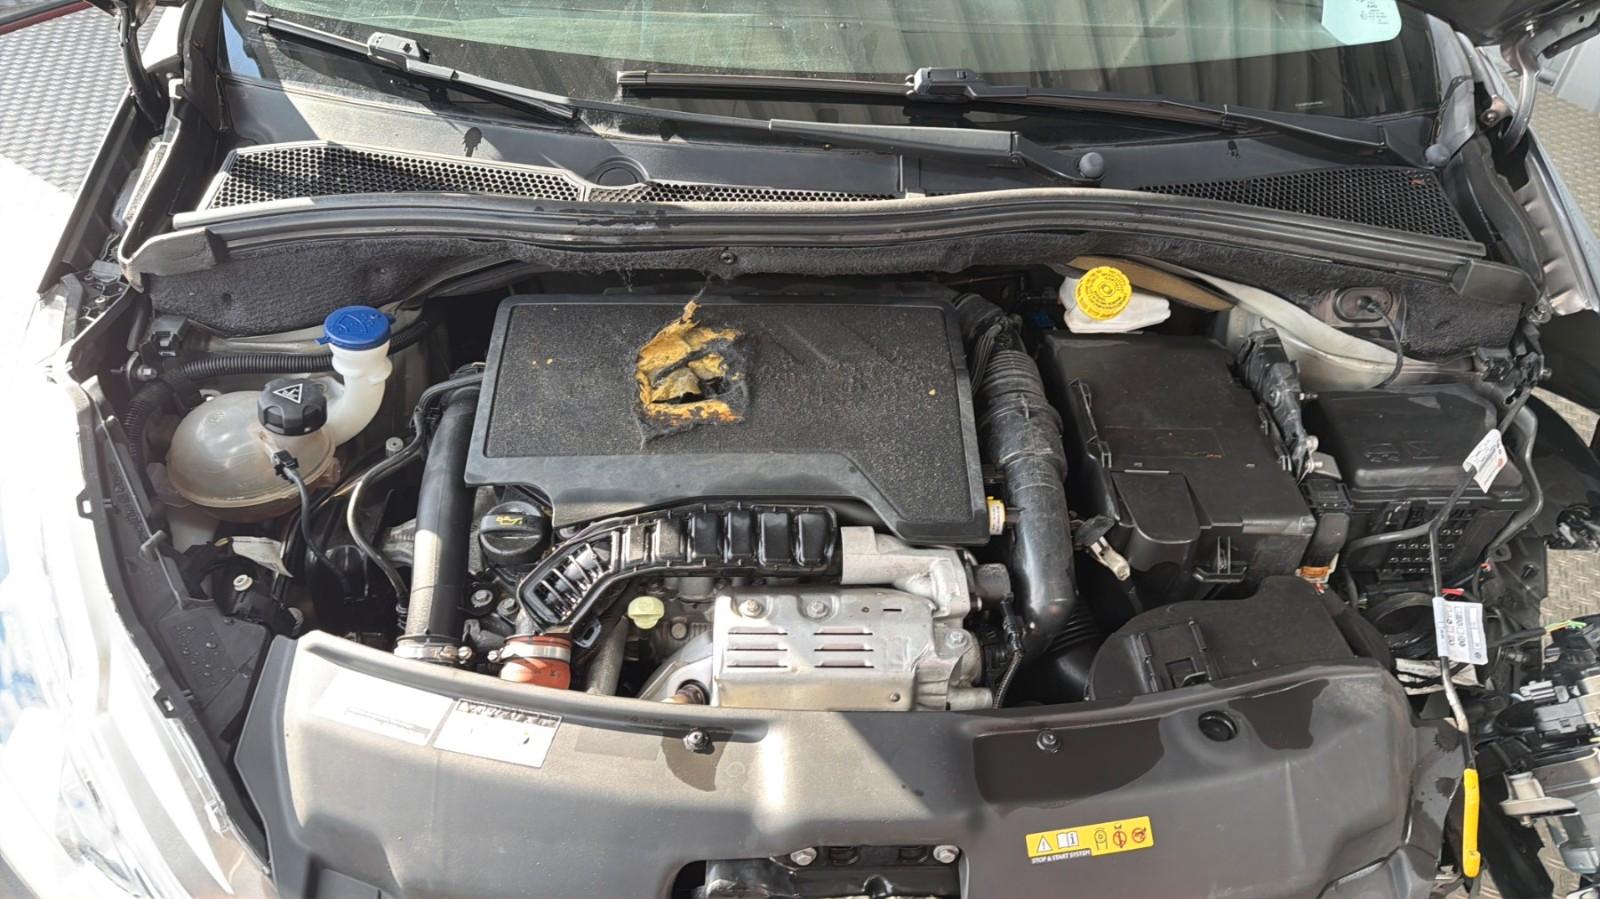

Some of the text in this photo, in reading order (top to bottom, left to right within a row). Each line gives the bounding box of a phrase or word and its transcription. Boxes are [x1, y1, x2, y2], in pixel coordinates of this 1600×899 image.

[1032, 856, 1047, 864] STOP
[1052, 853, 1069, 861] START
[1069, 850, 1090, 858] SYSTEM
